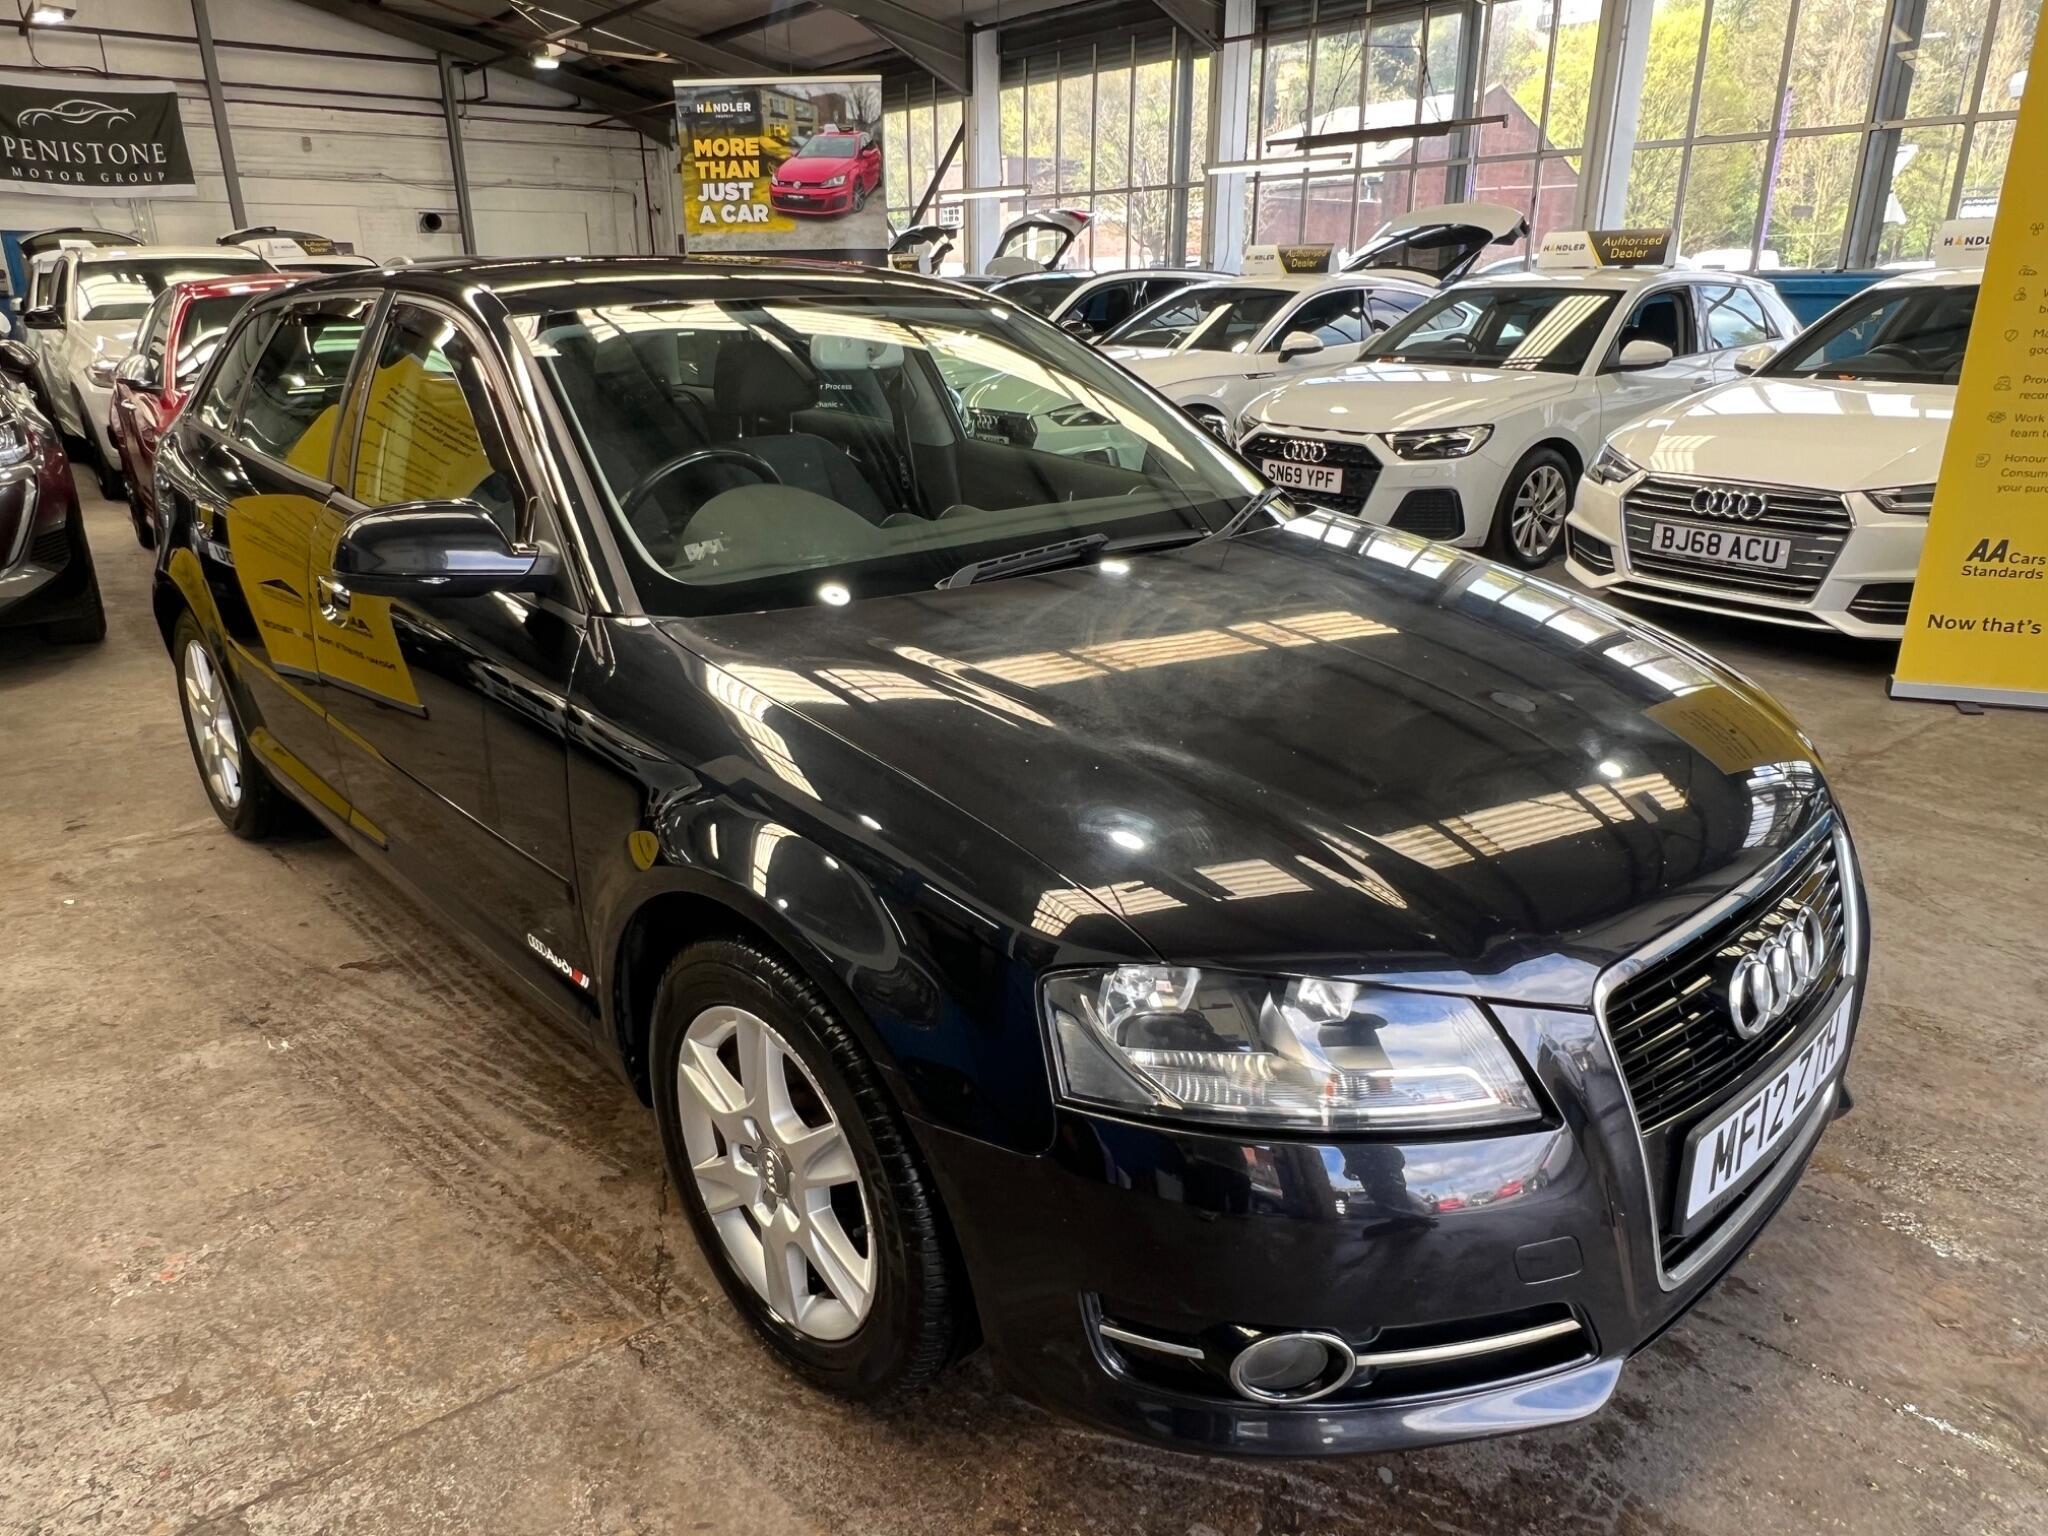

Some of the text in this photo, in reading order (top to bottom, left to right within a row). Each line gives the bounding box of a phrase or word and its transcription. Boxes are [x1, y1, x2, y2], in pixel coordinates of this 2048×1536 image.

[697, 101, 751, 114] HANDLER
[1, 135, 167, 165] PENISTONE
[694, 138, 760, 158] MORE
[11, 166, 165, 183] MOTOR GROUP
[695, 160, 760, 180] THAN
[698, 182, 754, 202] JUST
[699, 204, 769, 224] A CAR
[1602, 233, 1665, 247] Authorised
[1610, 246, 1649, 259] Dealer
[1291, 258, 1319, 268] Dealer
[2014, 413, 2045, 423] Work
[2010, 429, 2039, 438] team
[1268, 463, 1335, 488] SN69 YPF
[1997, 484, 2022, 494] your
[1660, 526, 1780, 564] BJ68 ACU
[1966, 538, 2046, 566] AA Cars
[1961, 565, 2044, 580] Standards
[1927, 613, 2042, 635] Now that's
[1708, 1006, 1841, 1194] MF12 ZTH
